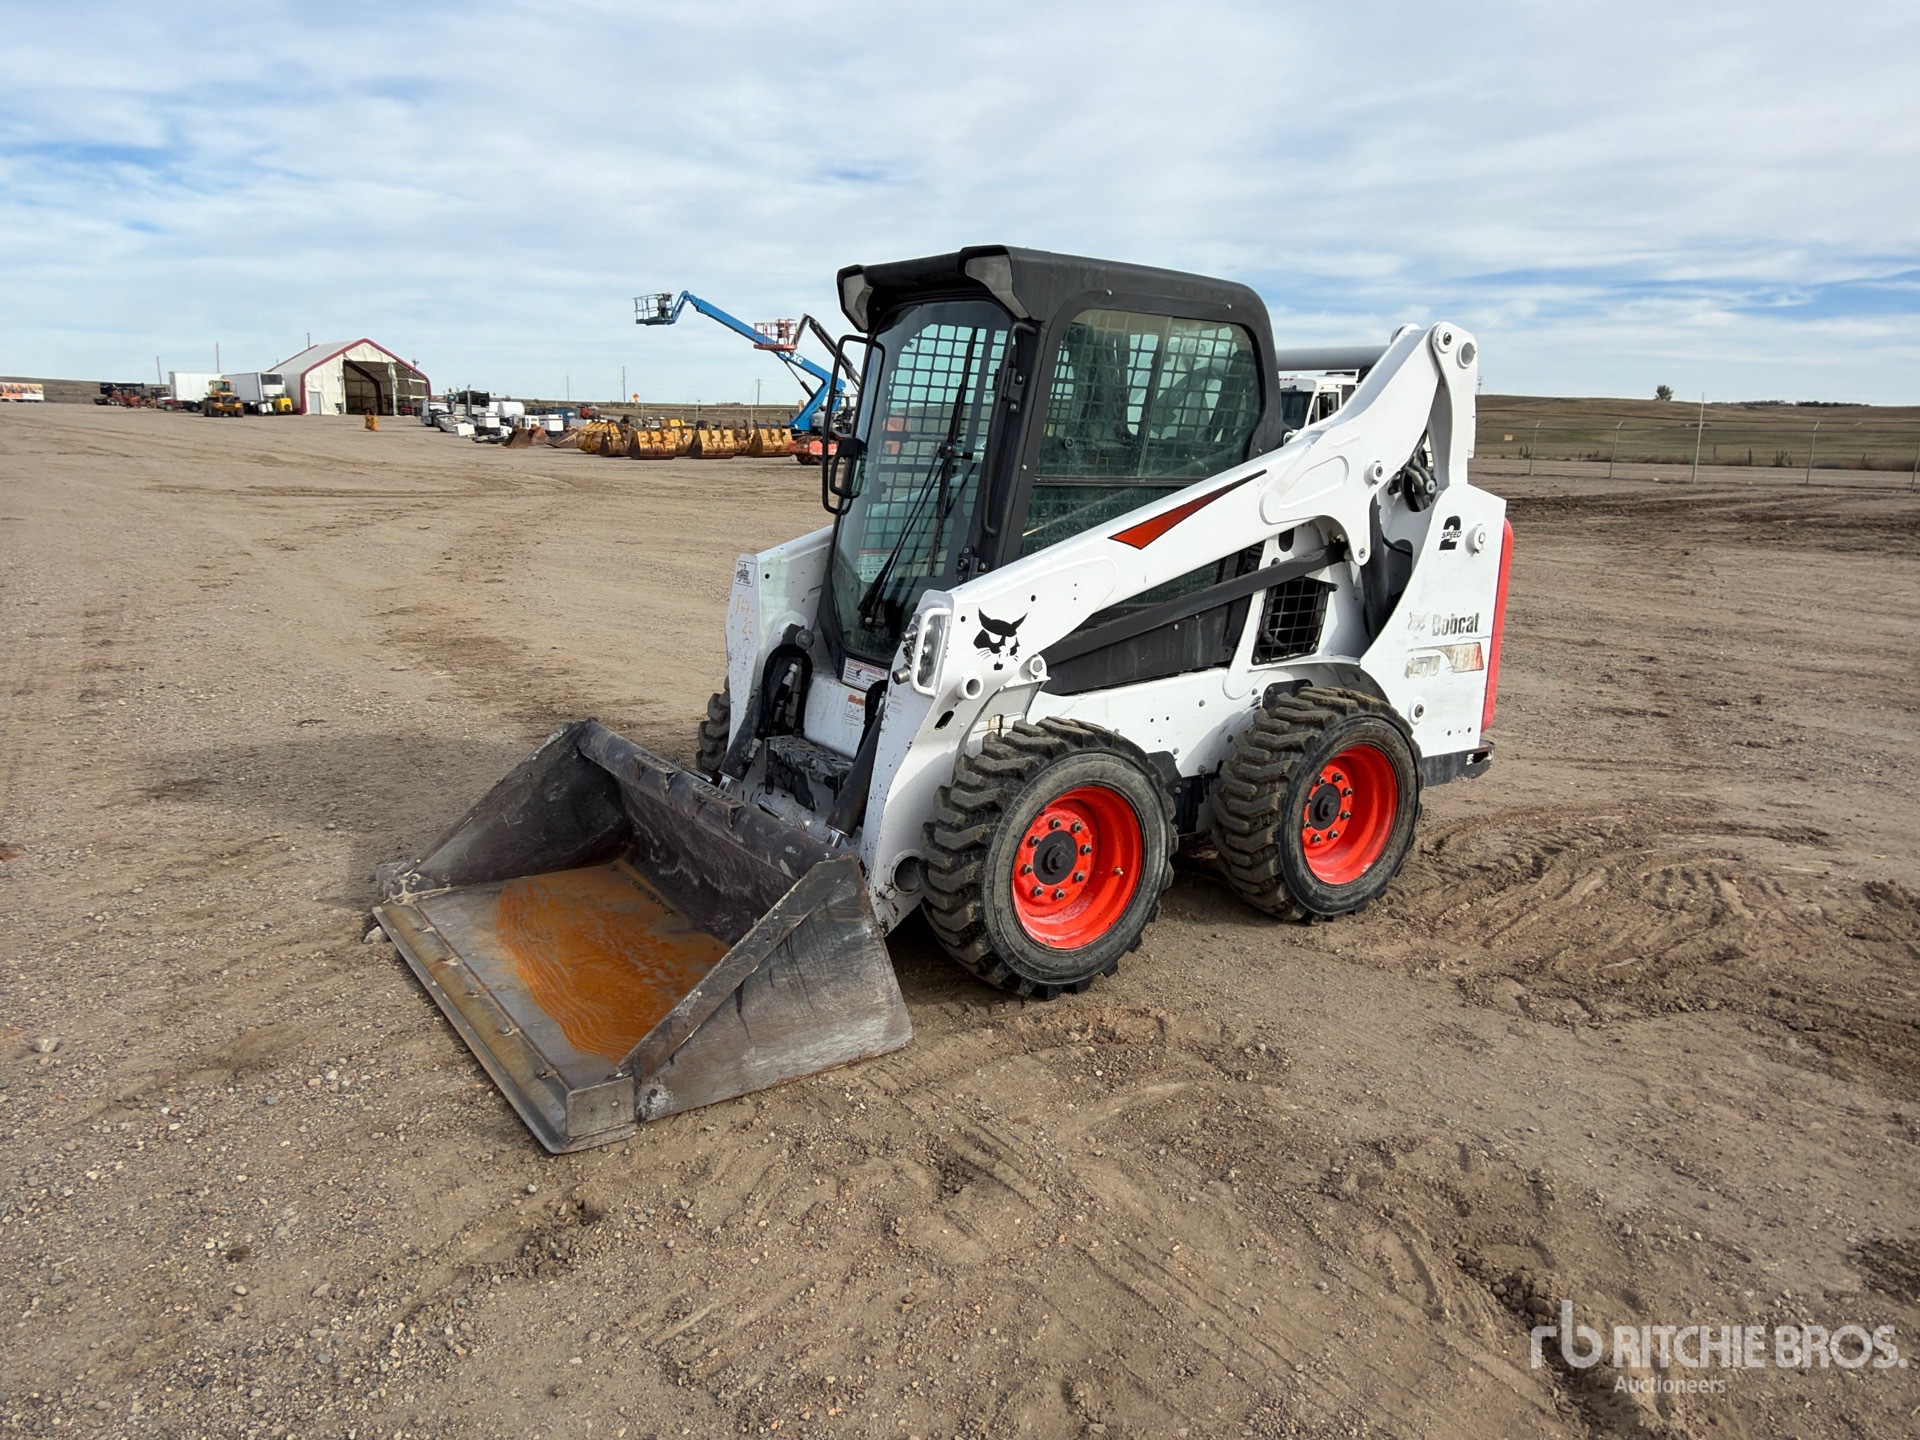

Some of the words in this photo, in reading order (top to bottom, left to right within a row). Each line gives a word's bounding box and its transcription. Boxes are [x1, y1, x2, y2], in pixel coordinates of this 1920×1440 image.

[1439, 515, 1461, 551] 2
[1441, 531, 1462, 539] SPEED
[1432, 612, 1480, 636] Bobcat
